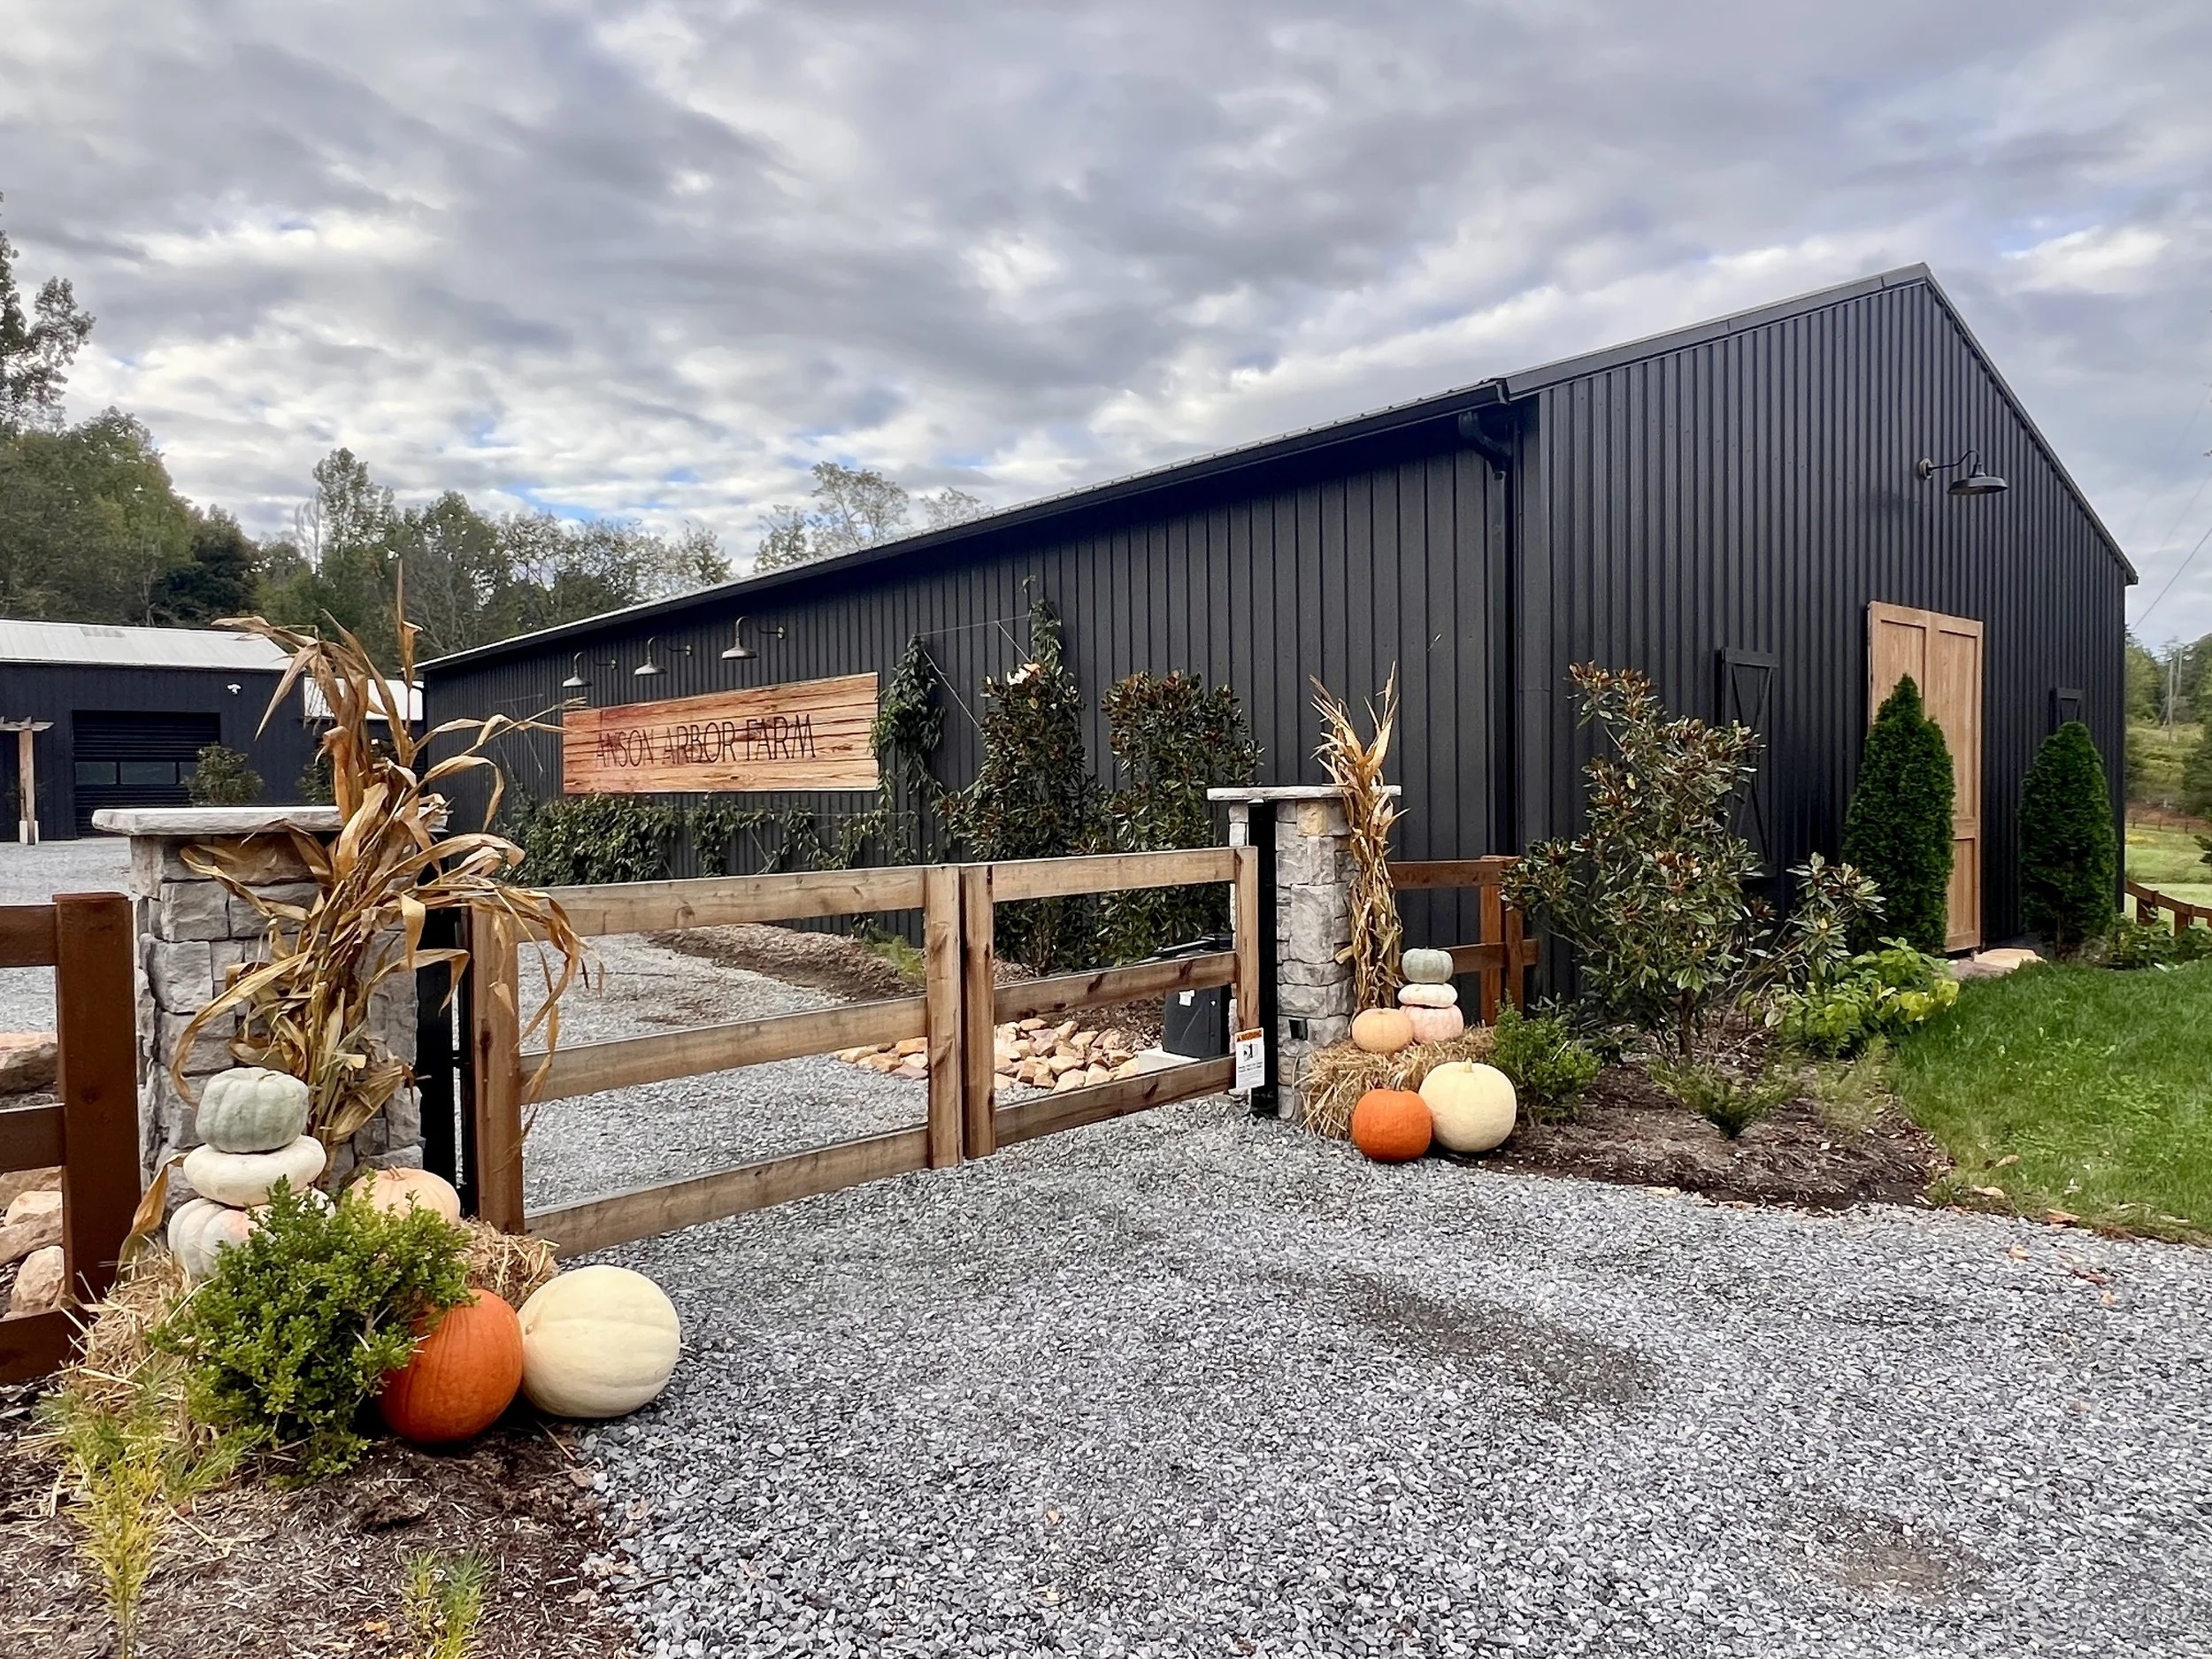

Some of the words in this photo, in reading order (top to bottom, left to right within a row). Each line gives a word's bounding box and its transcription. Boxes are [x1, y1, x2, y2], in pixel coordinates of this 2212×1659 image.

[595, 729, 655, 767] ANSON
[664, 721, 736, 764] ARBOR
[747, 714, 816, 761] FARM
